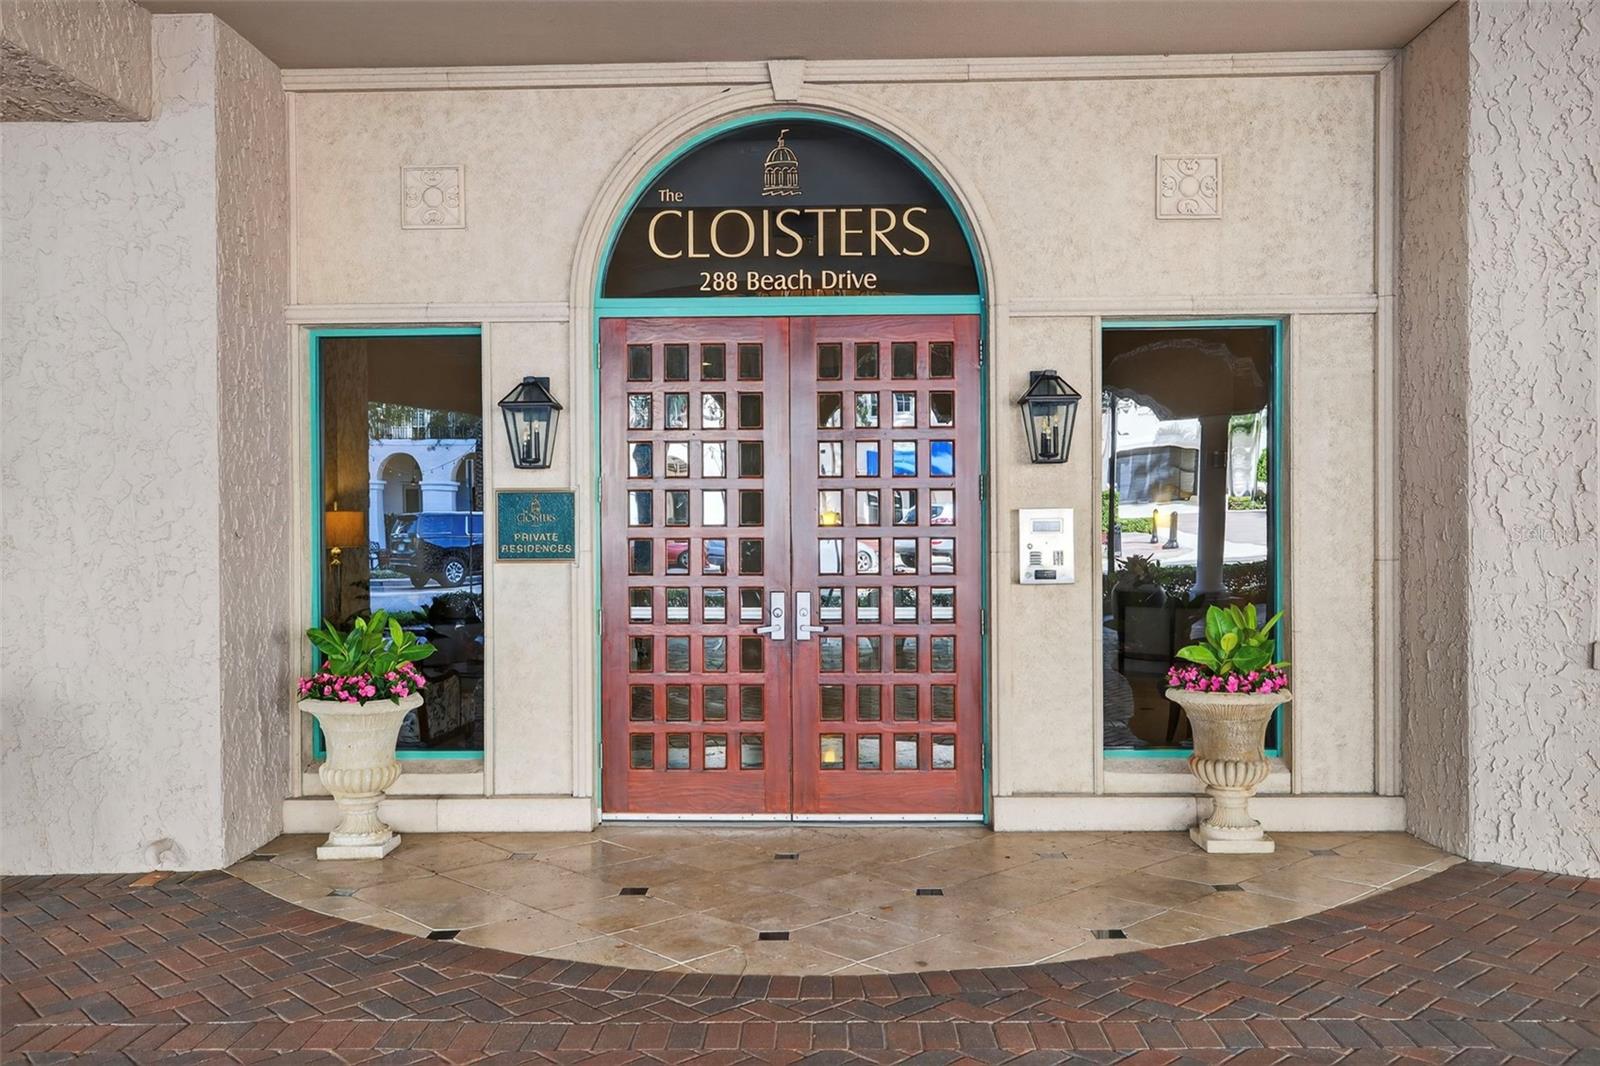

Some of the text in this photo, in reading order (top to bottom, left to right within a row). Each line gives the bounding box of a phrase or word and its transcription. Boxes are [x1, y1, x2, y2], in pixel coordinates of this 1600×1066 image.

[658, 188, 684, 202] The
[648, 206, 930, 259] CLOISTERS
[699, 269, 877, 291] 288 Beach Drive
[514, 532, 559, 542] PRIVATE
[501, 544, 572, 553] RESIDENCES
